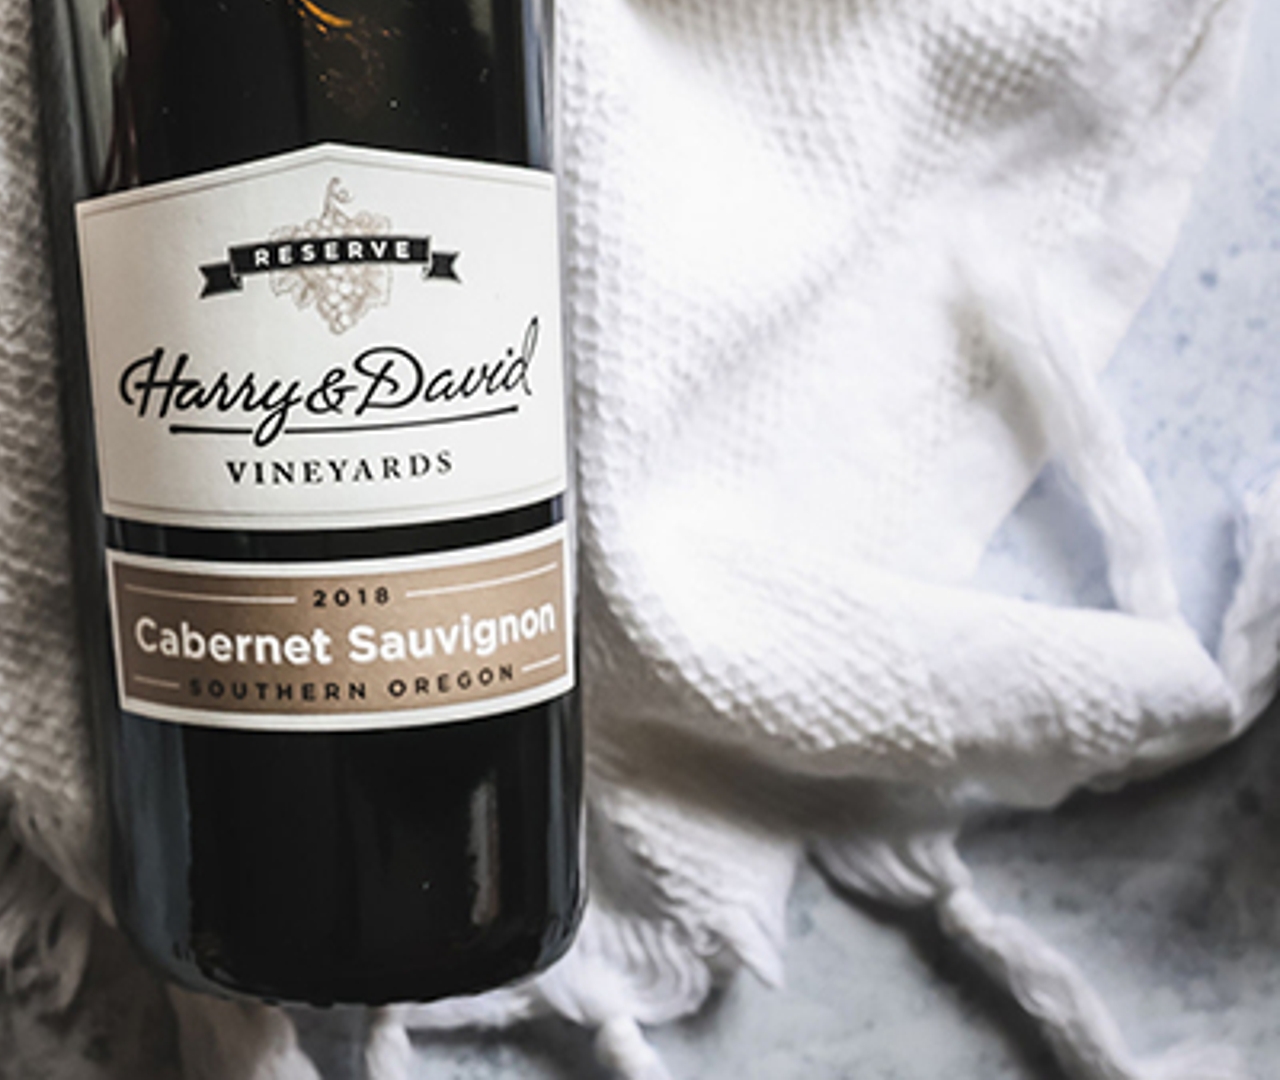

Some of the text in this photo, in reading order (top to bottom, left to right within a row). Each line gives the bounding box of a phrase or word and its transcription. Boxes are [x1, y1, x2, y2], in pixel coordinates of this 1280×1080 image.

[254, 240, 411, 266] RESERVE
[226, 451, 453, 485] VINEYARDS
[313, 587, 390, 608] 2018
[135, 603, 555, 665] Cabernet Sauvignon
[189, 664, 514, 702] SOUTHERN OREGON
